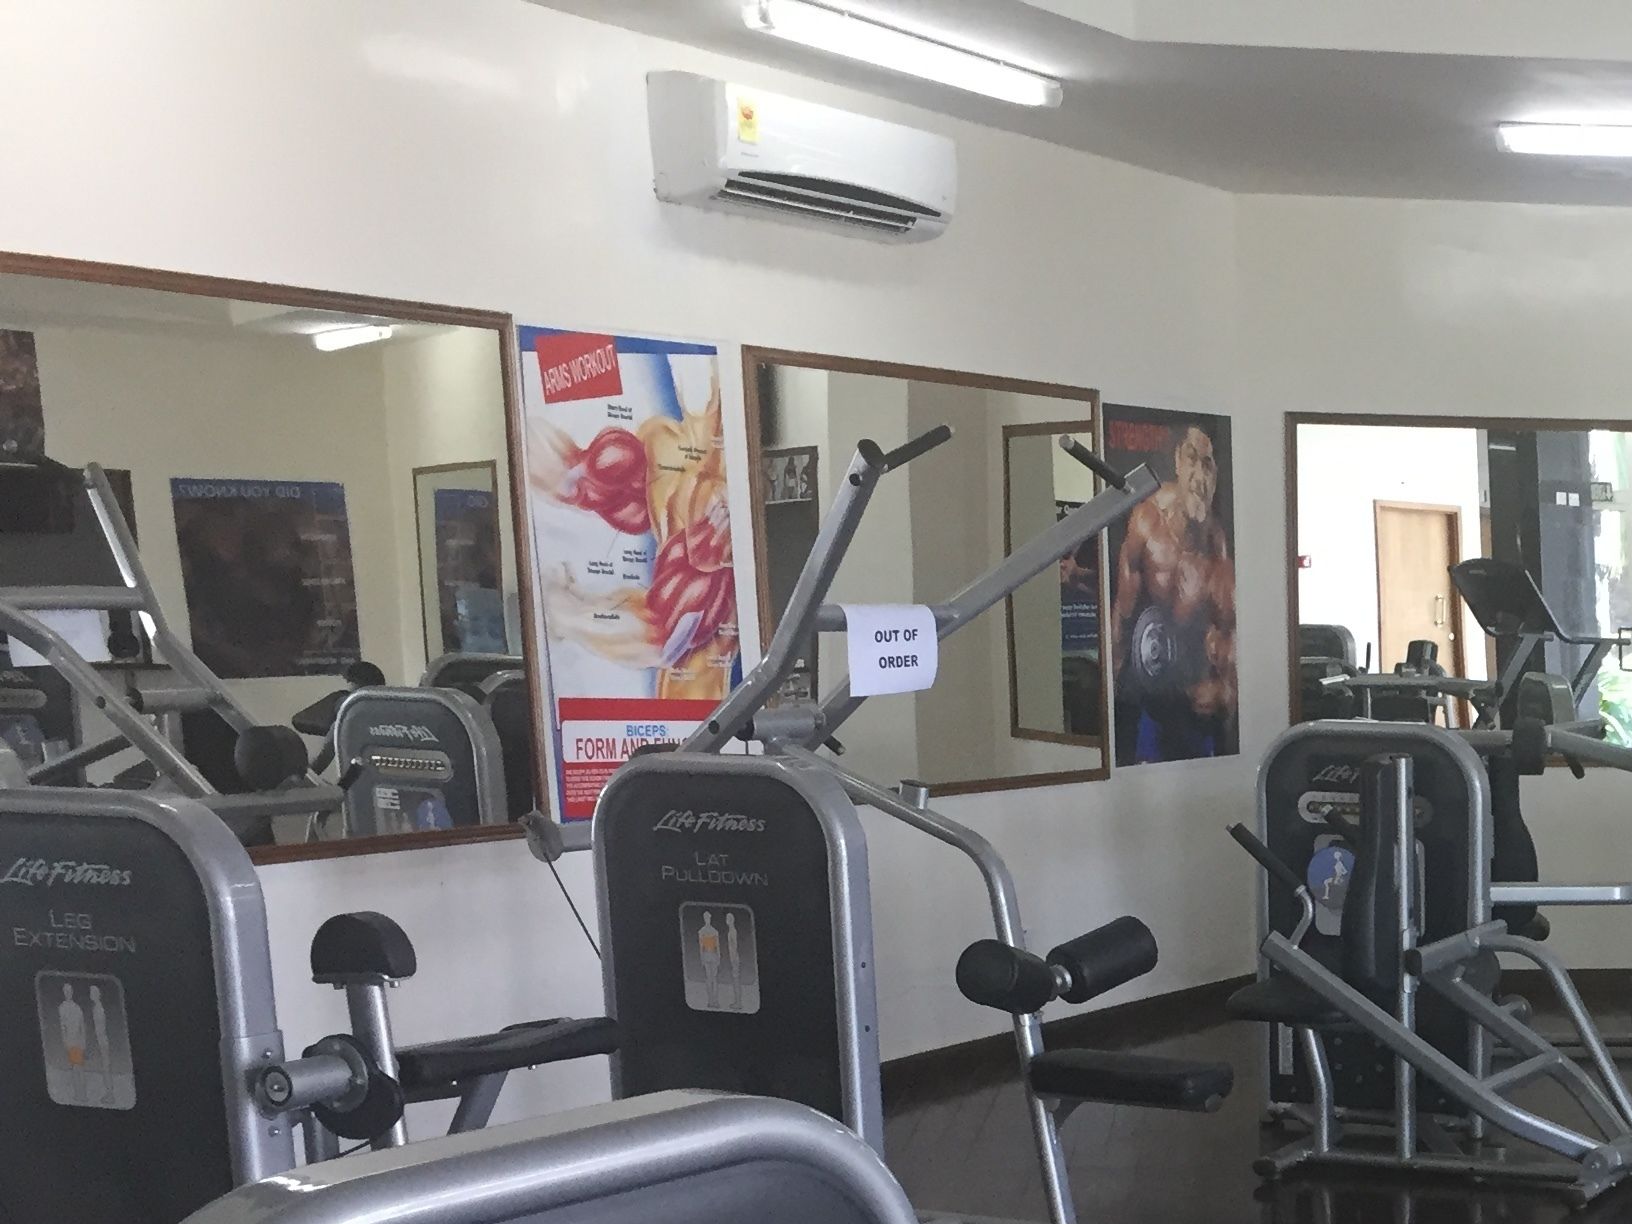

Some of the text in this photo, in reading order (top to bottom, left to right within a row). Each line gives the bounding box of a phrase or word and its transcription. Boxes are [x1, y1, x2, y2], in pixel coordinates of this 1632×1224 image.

[543, 344, 617, 396] ARMS WORKOUT
[874, 628, 918, 643] OUT OF
[878, 655, 919, 669] ORDER
[575, 738, 617, 760] FORM
[694, 851, 729, 866] LAT
[661, 865, 769, 886] PULLDOWN
[49, 909, 92, 930] LEG
[13, 927, 136, 953] EXTENSION
